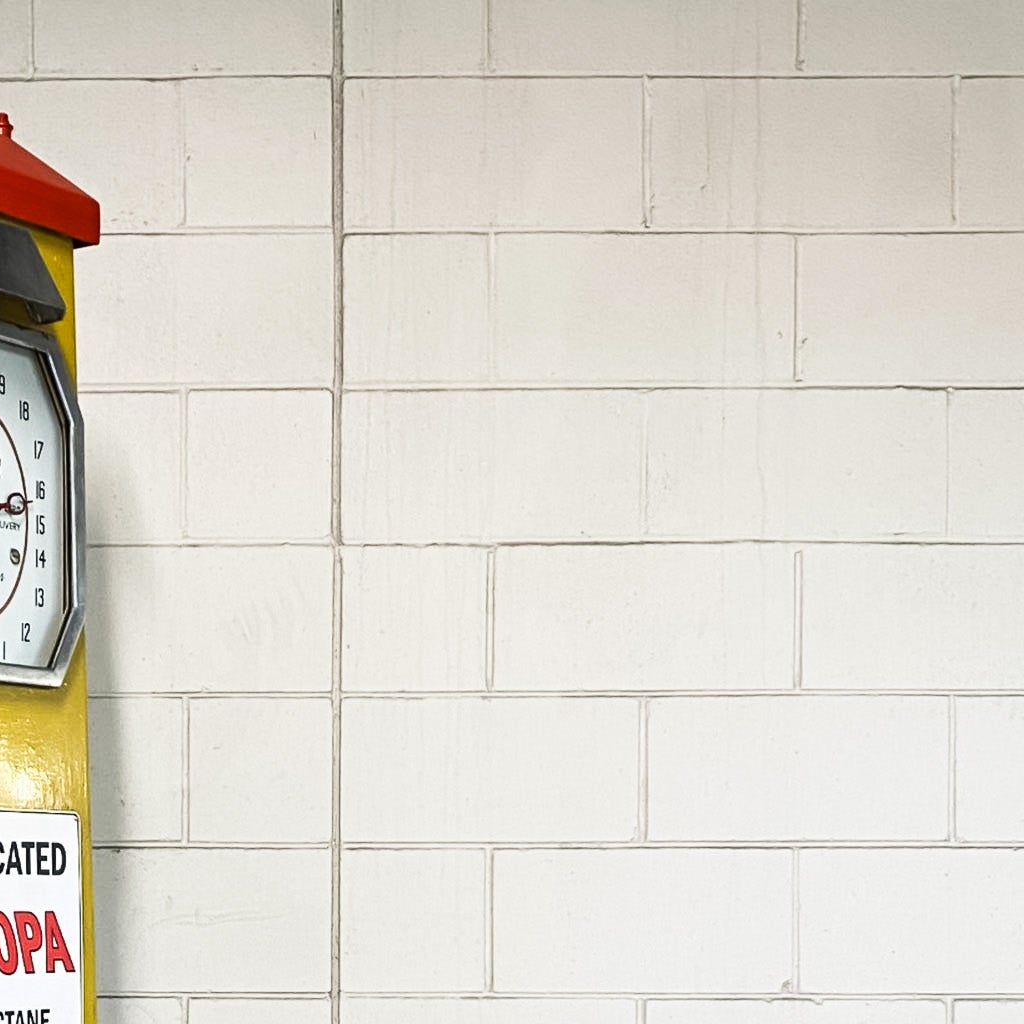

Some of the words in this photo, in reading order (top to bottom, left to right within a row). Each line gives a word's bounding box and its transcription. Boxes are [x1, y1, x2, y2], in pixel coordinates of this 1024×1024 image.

[19, 400, 30, 421] 18
[34, 440, 44, 460] 17
[36, 480, 46, 500] 16
[36, 514, 46, 535] 15
[35, 549, 47, 569] 14
[35, 588, 45, 608] 13
[21, 622, 31, 643] 12
